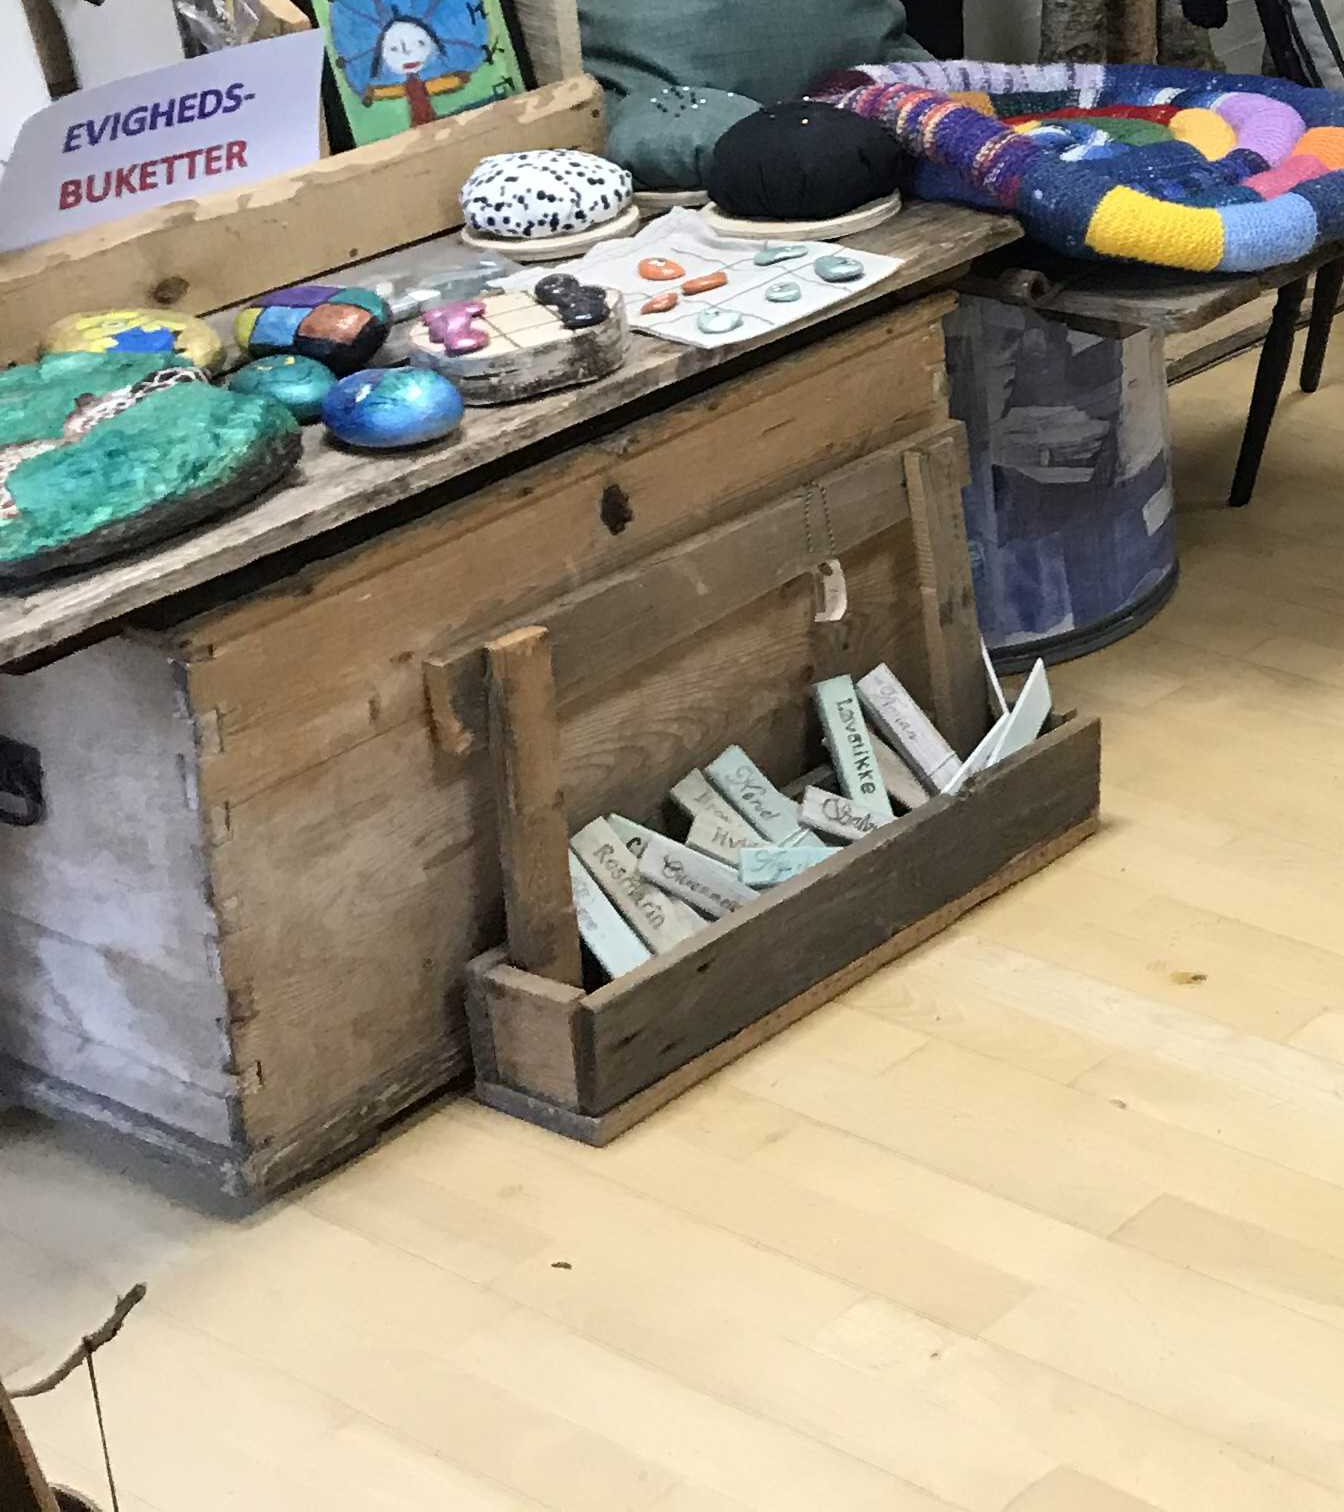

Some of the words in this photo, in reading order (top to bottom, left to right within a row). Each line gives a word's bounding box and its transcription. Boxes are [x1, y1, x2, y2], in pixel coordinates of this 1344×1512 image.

[61, 82, 257, 154] EVIGHEDS-
[58, 139, 249, 211] BUKETTER
[592, 842, 666, 930] Rosmarin
